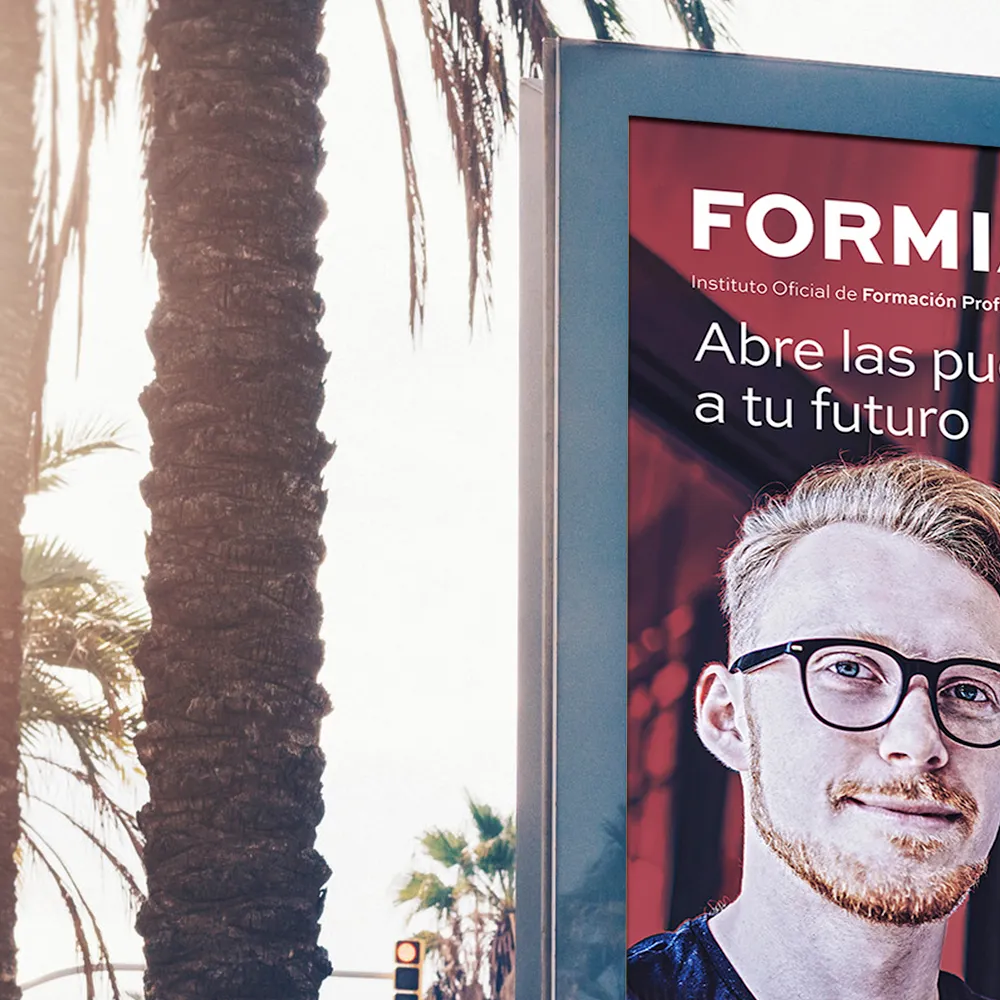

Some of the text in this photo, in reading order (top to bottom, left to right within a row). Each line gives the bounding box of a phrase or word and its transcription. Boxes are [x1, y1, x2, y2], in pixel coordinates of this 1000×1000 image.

[691, 275, 768, 295] Instituto
[771, 280, 831, 301] Oficial
[834, 285, 858, 302] de
[862, 287, 956, 308] Formación
[694, 321, 824, 370] Abre
[843, 328, 916, 377] las
[694, 387, 970, 441] a tu futuro
